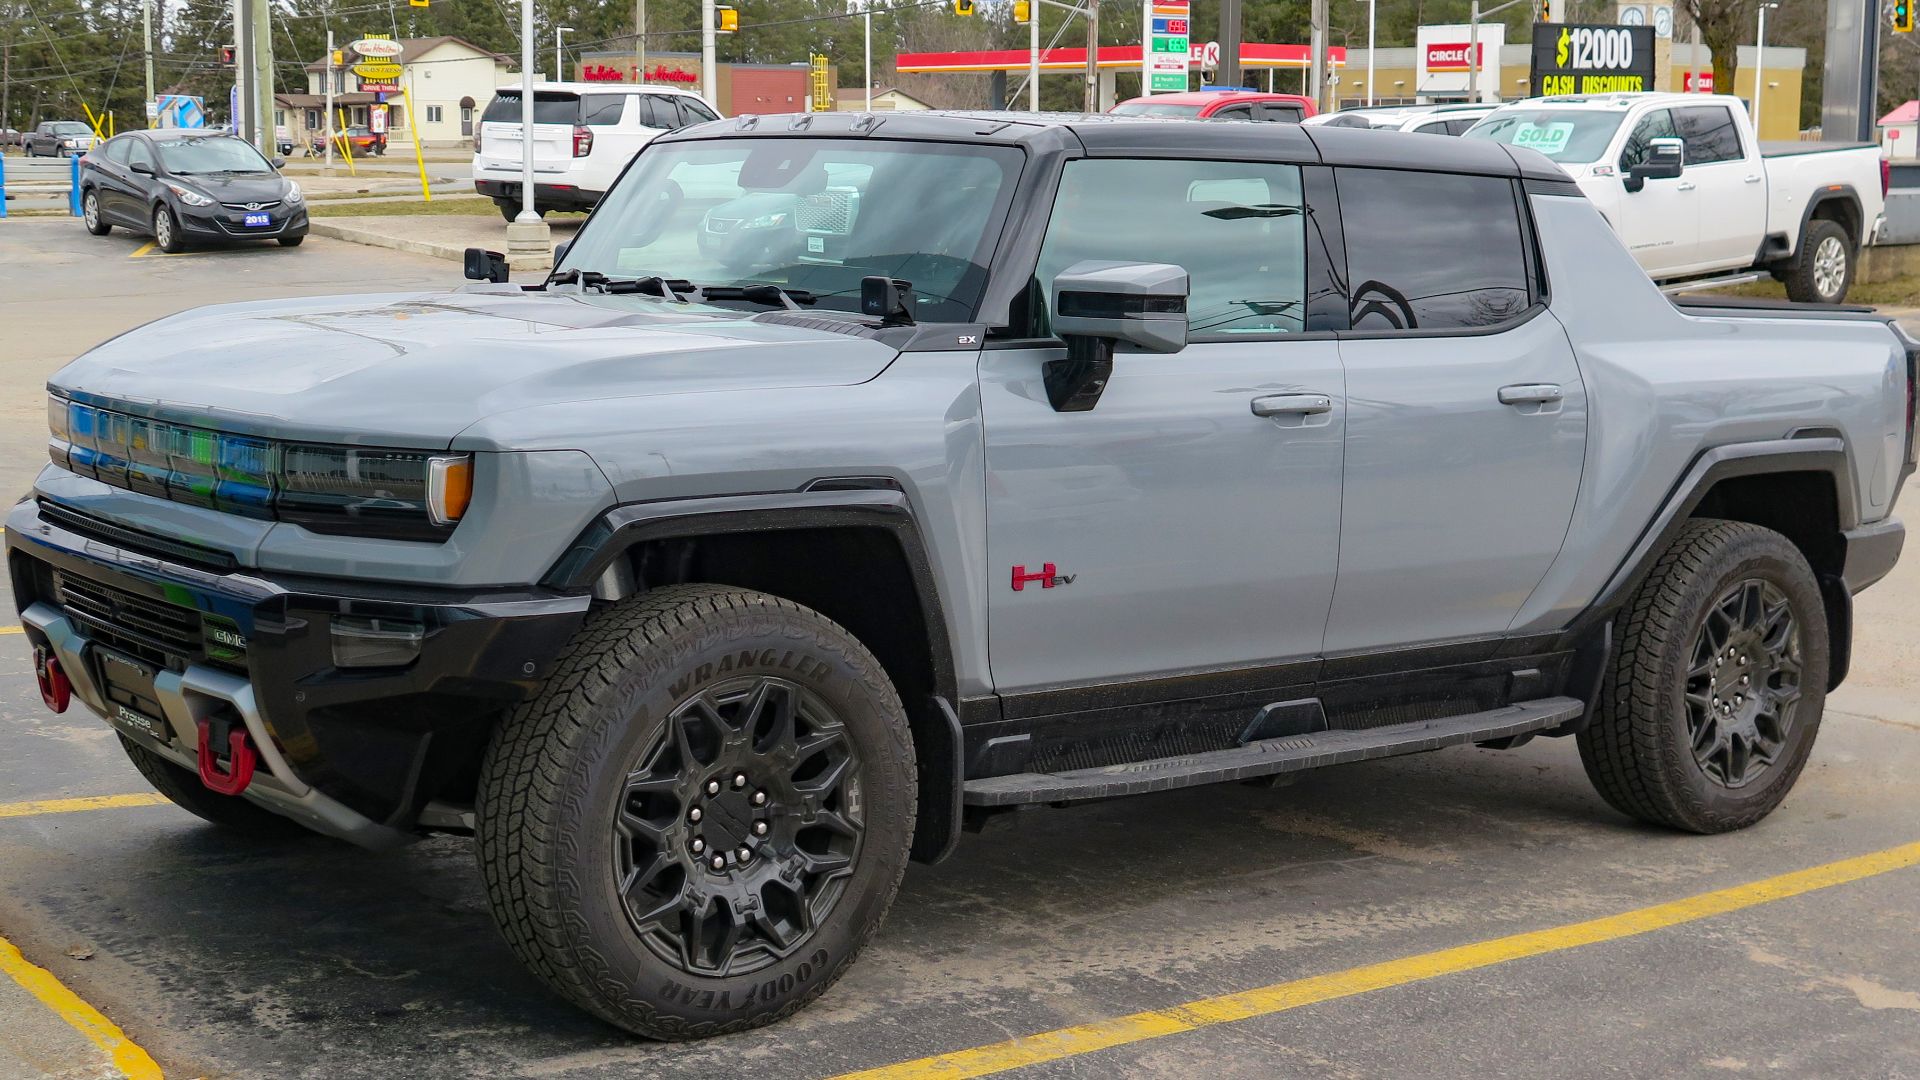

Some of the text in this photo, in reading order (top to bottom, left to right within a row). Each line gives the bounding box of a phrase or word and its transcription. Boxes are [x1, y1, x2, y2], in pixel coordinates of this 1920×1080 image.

[1429, 50, 1464, 61] CIRCLE
[1555, 27, 1633, 69] $12000
[631, 64, 697, 82] Tm Hortons
[1543, 75, 1643, 96] CASH DISCOUNTS
[1518, 128, 1565, 142] SOLD
[245, 215, 269, 224] 2015
[958, 335, 977, 344] 2X
[213, 628, 247, 649] GMC
[667, 648, 833, 701] WRANGLER
[118, 705, 151, 728] Prouse
